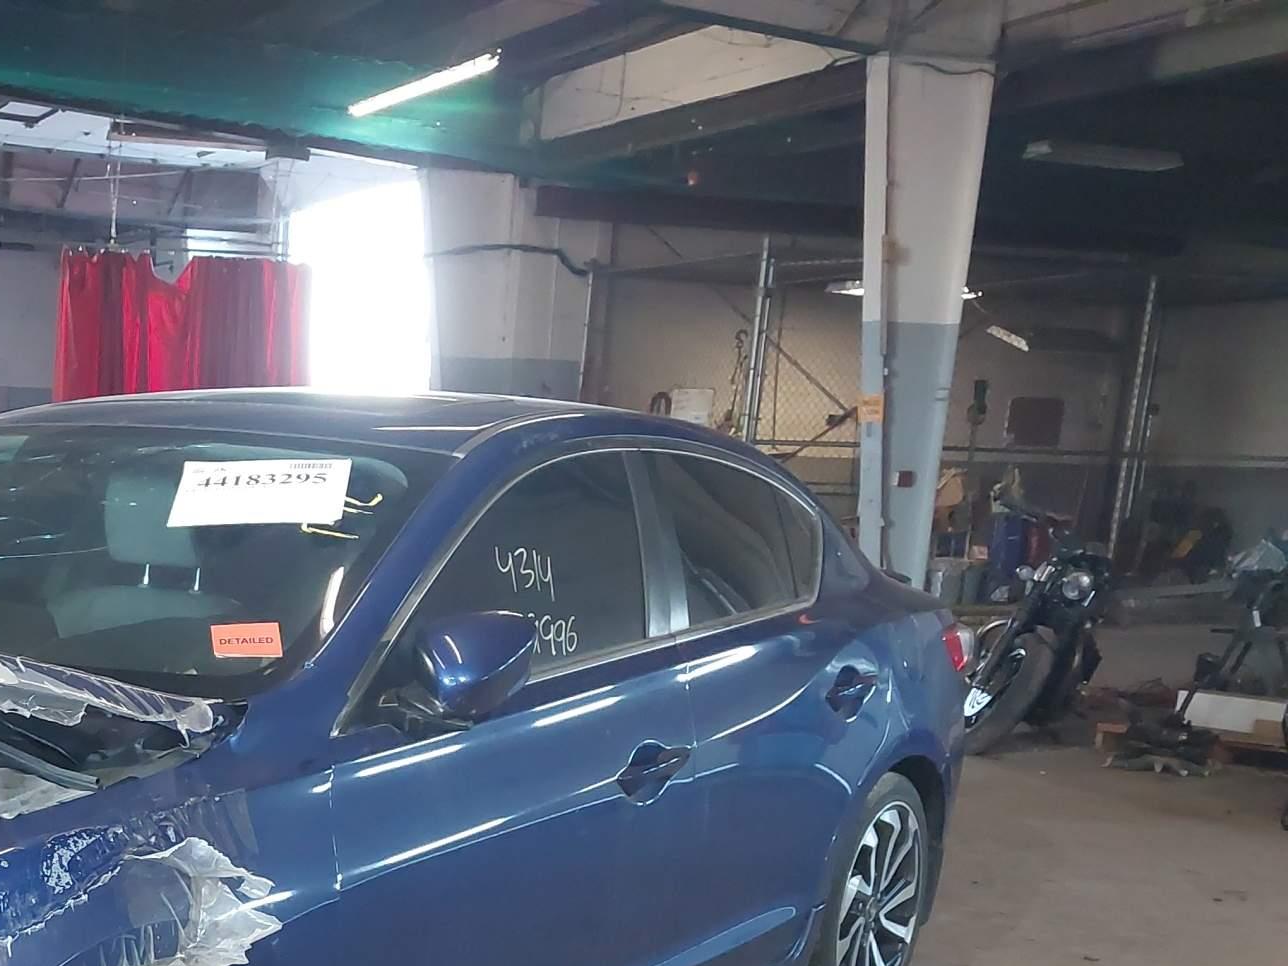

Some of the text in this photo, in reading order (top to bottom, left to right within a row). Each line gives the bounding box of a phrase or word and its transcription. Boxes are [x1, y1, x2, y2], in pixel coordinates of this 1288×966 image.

[197, 473, 328, 488] 44183295
[494, 546, 556, 602] 4314
[219, 637, 274, 646] DETAILED
